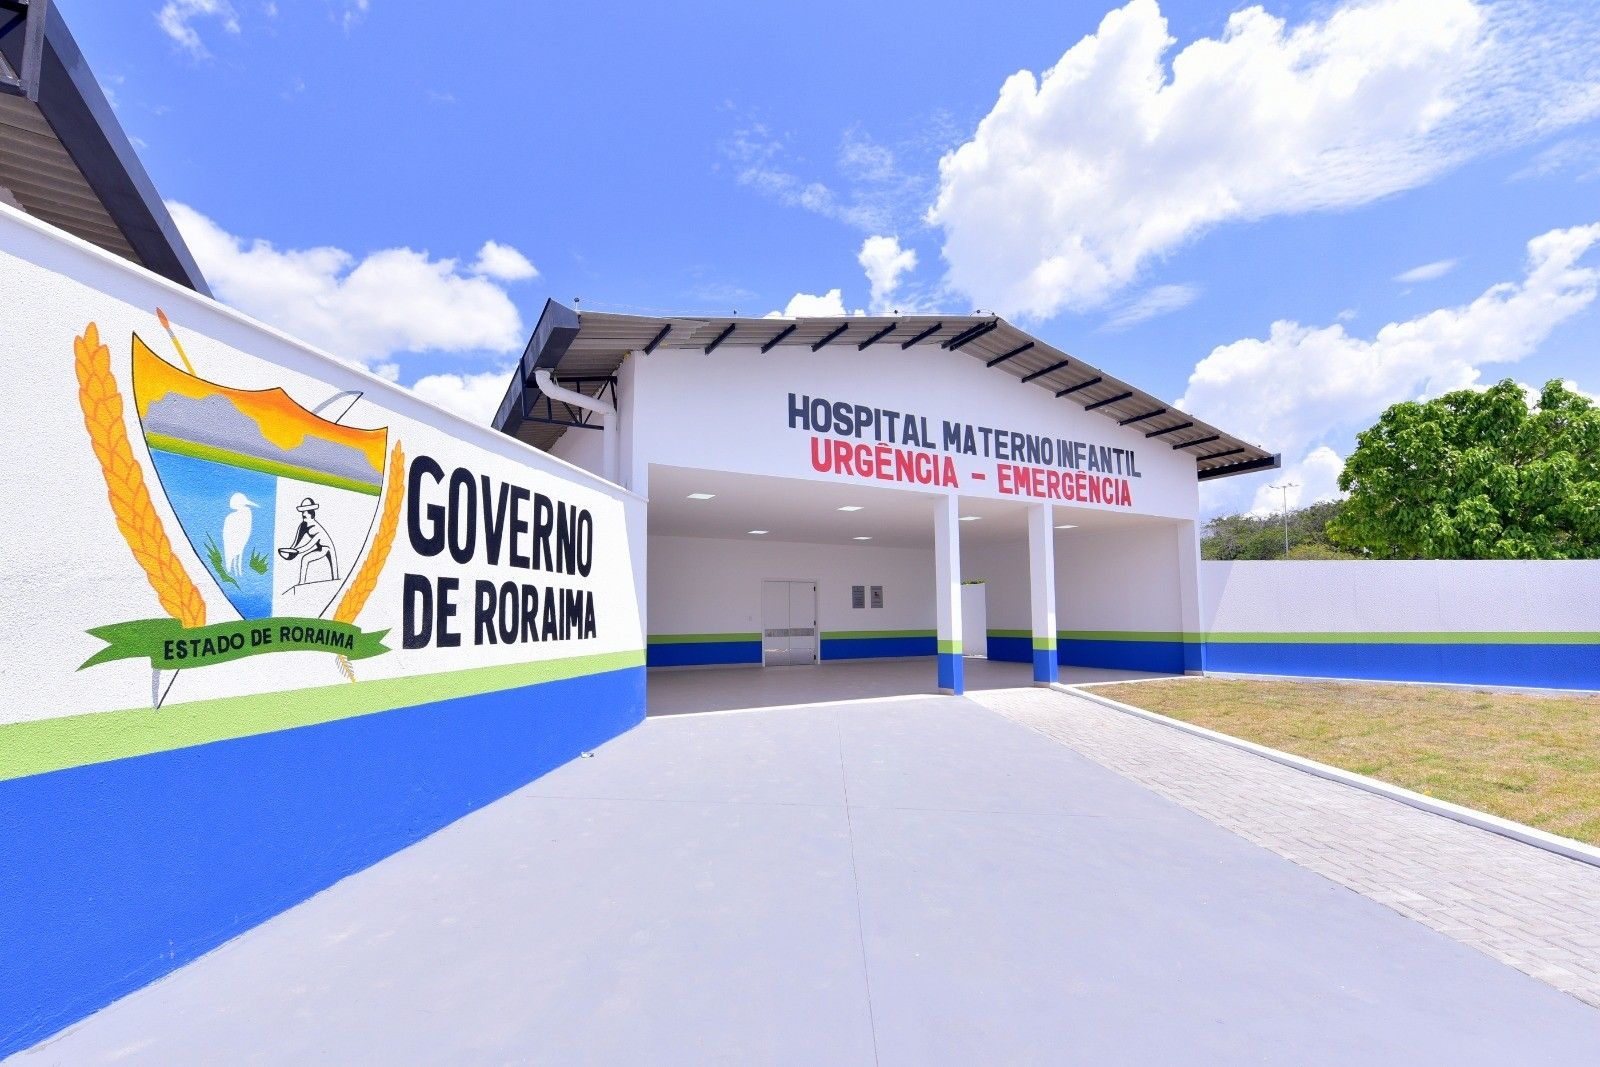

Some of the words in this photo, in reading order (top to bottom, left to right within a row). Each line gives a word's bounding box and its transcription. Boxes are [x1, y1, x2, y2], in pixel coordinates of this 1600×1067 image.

[788, 393, 936, 450] HOSPITAL
[810, 436, 959, 488] URGÊNCIA
[996, 463, 1132, 507] EMERGÊNCIA
[407, 455, 593, 577] GOVERNO
[164, 632, 245, 661] ESTADO
[251, 627, 272, 647] DE
[279, 626, 354, 650] RORAIMA
[402, 573, 461, 650] DE
[474, 579, 597, 645] RORAIMA
